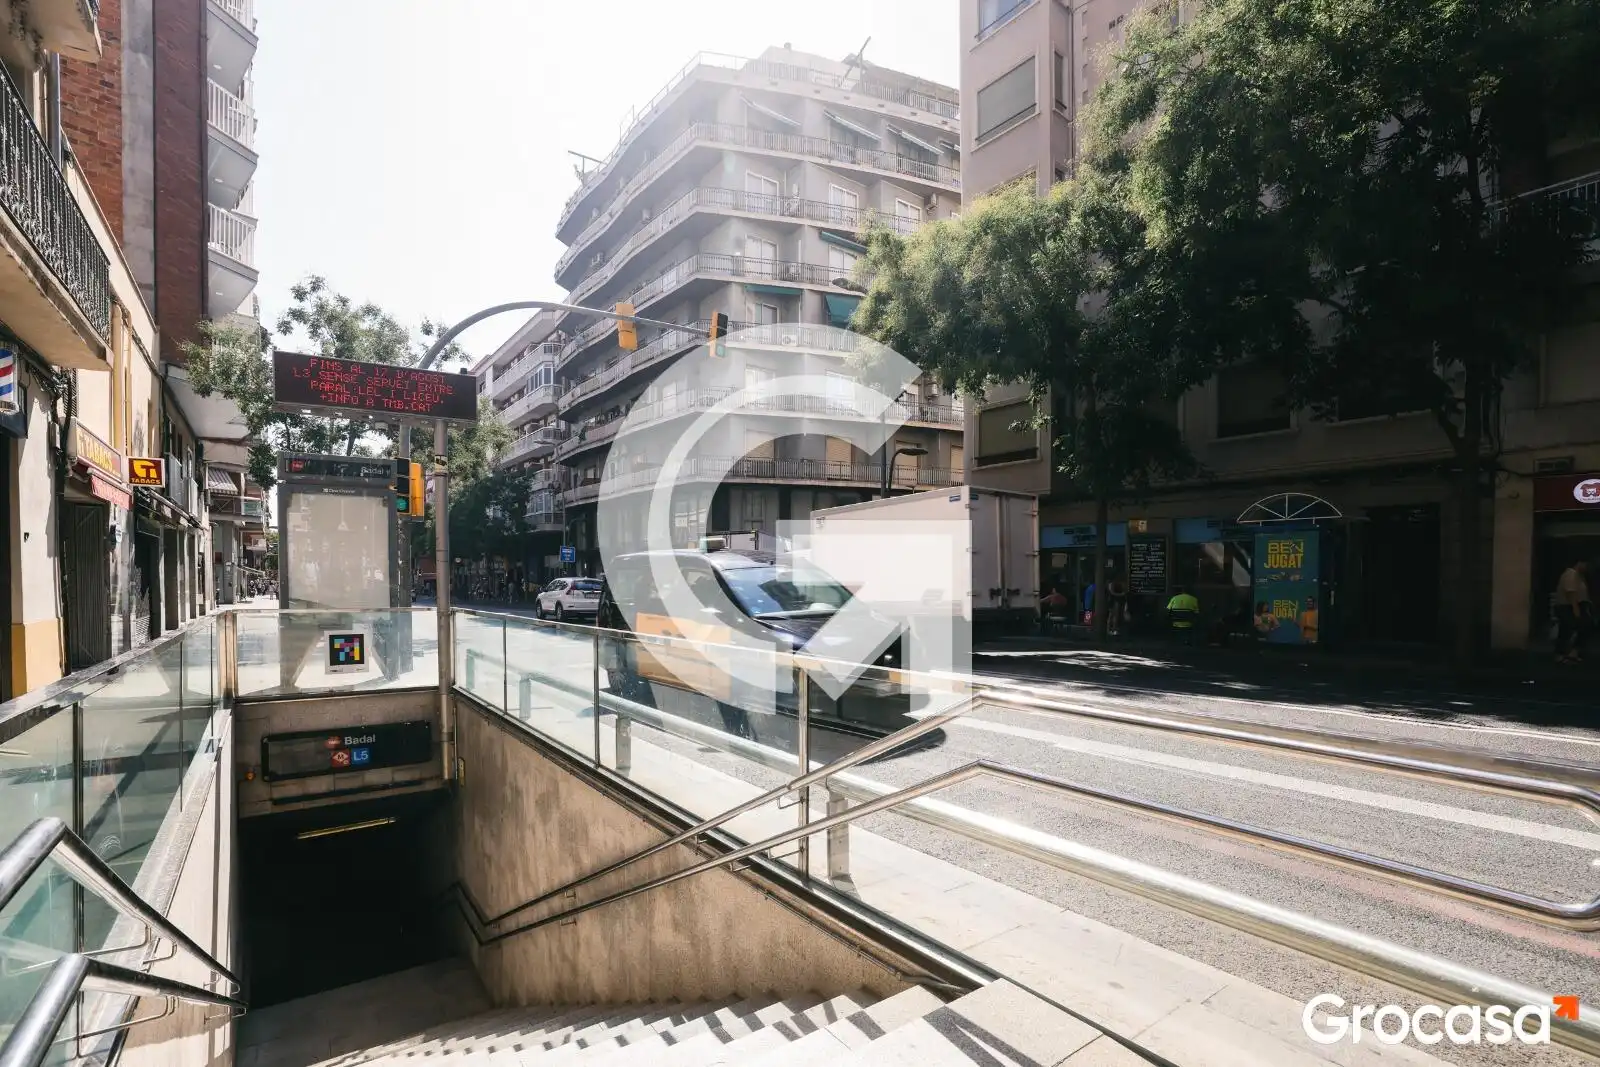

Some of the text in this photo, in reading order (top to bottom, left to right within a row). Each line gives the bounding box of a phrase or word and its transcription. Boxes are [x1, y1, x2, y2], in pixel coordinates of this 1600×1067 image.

[292, 366, 311, 378] L3
[319, 370, 358, 384] SENSE
[351, 363, 367, 374] AL
[373, 367, 388, 377] 17
[391, 389, 397, 399] I
[382, 398, 433, 412] TMB.CAT
[131, 477, 161, 485] TABACS
[1267, 541, 1304, 554] BEN
[1264, 553, 1303, 569] JUGAT
[1273, 599, 1298, 609] BEN
[344, 733, 376, 745] Badal
[353, 749, 369, 761] L5
